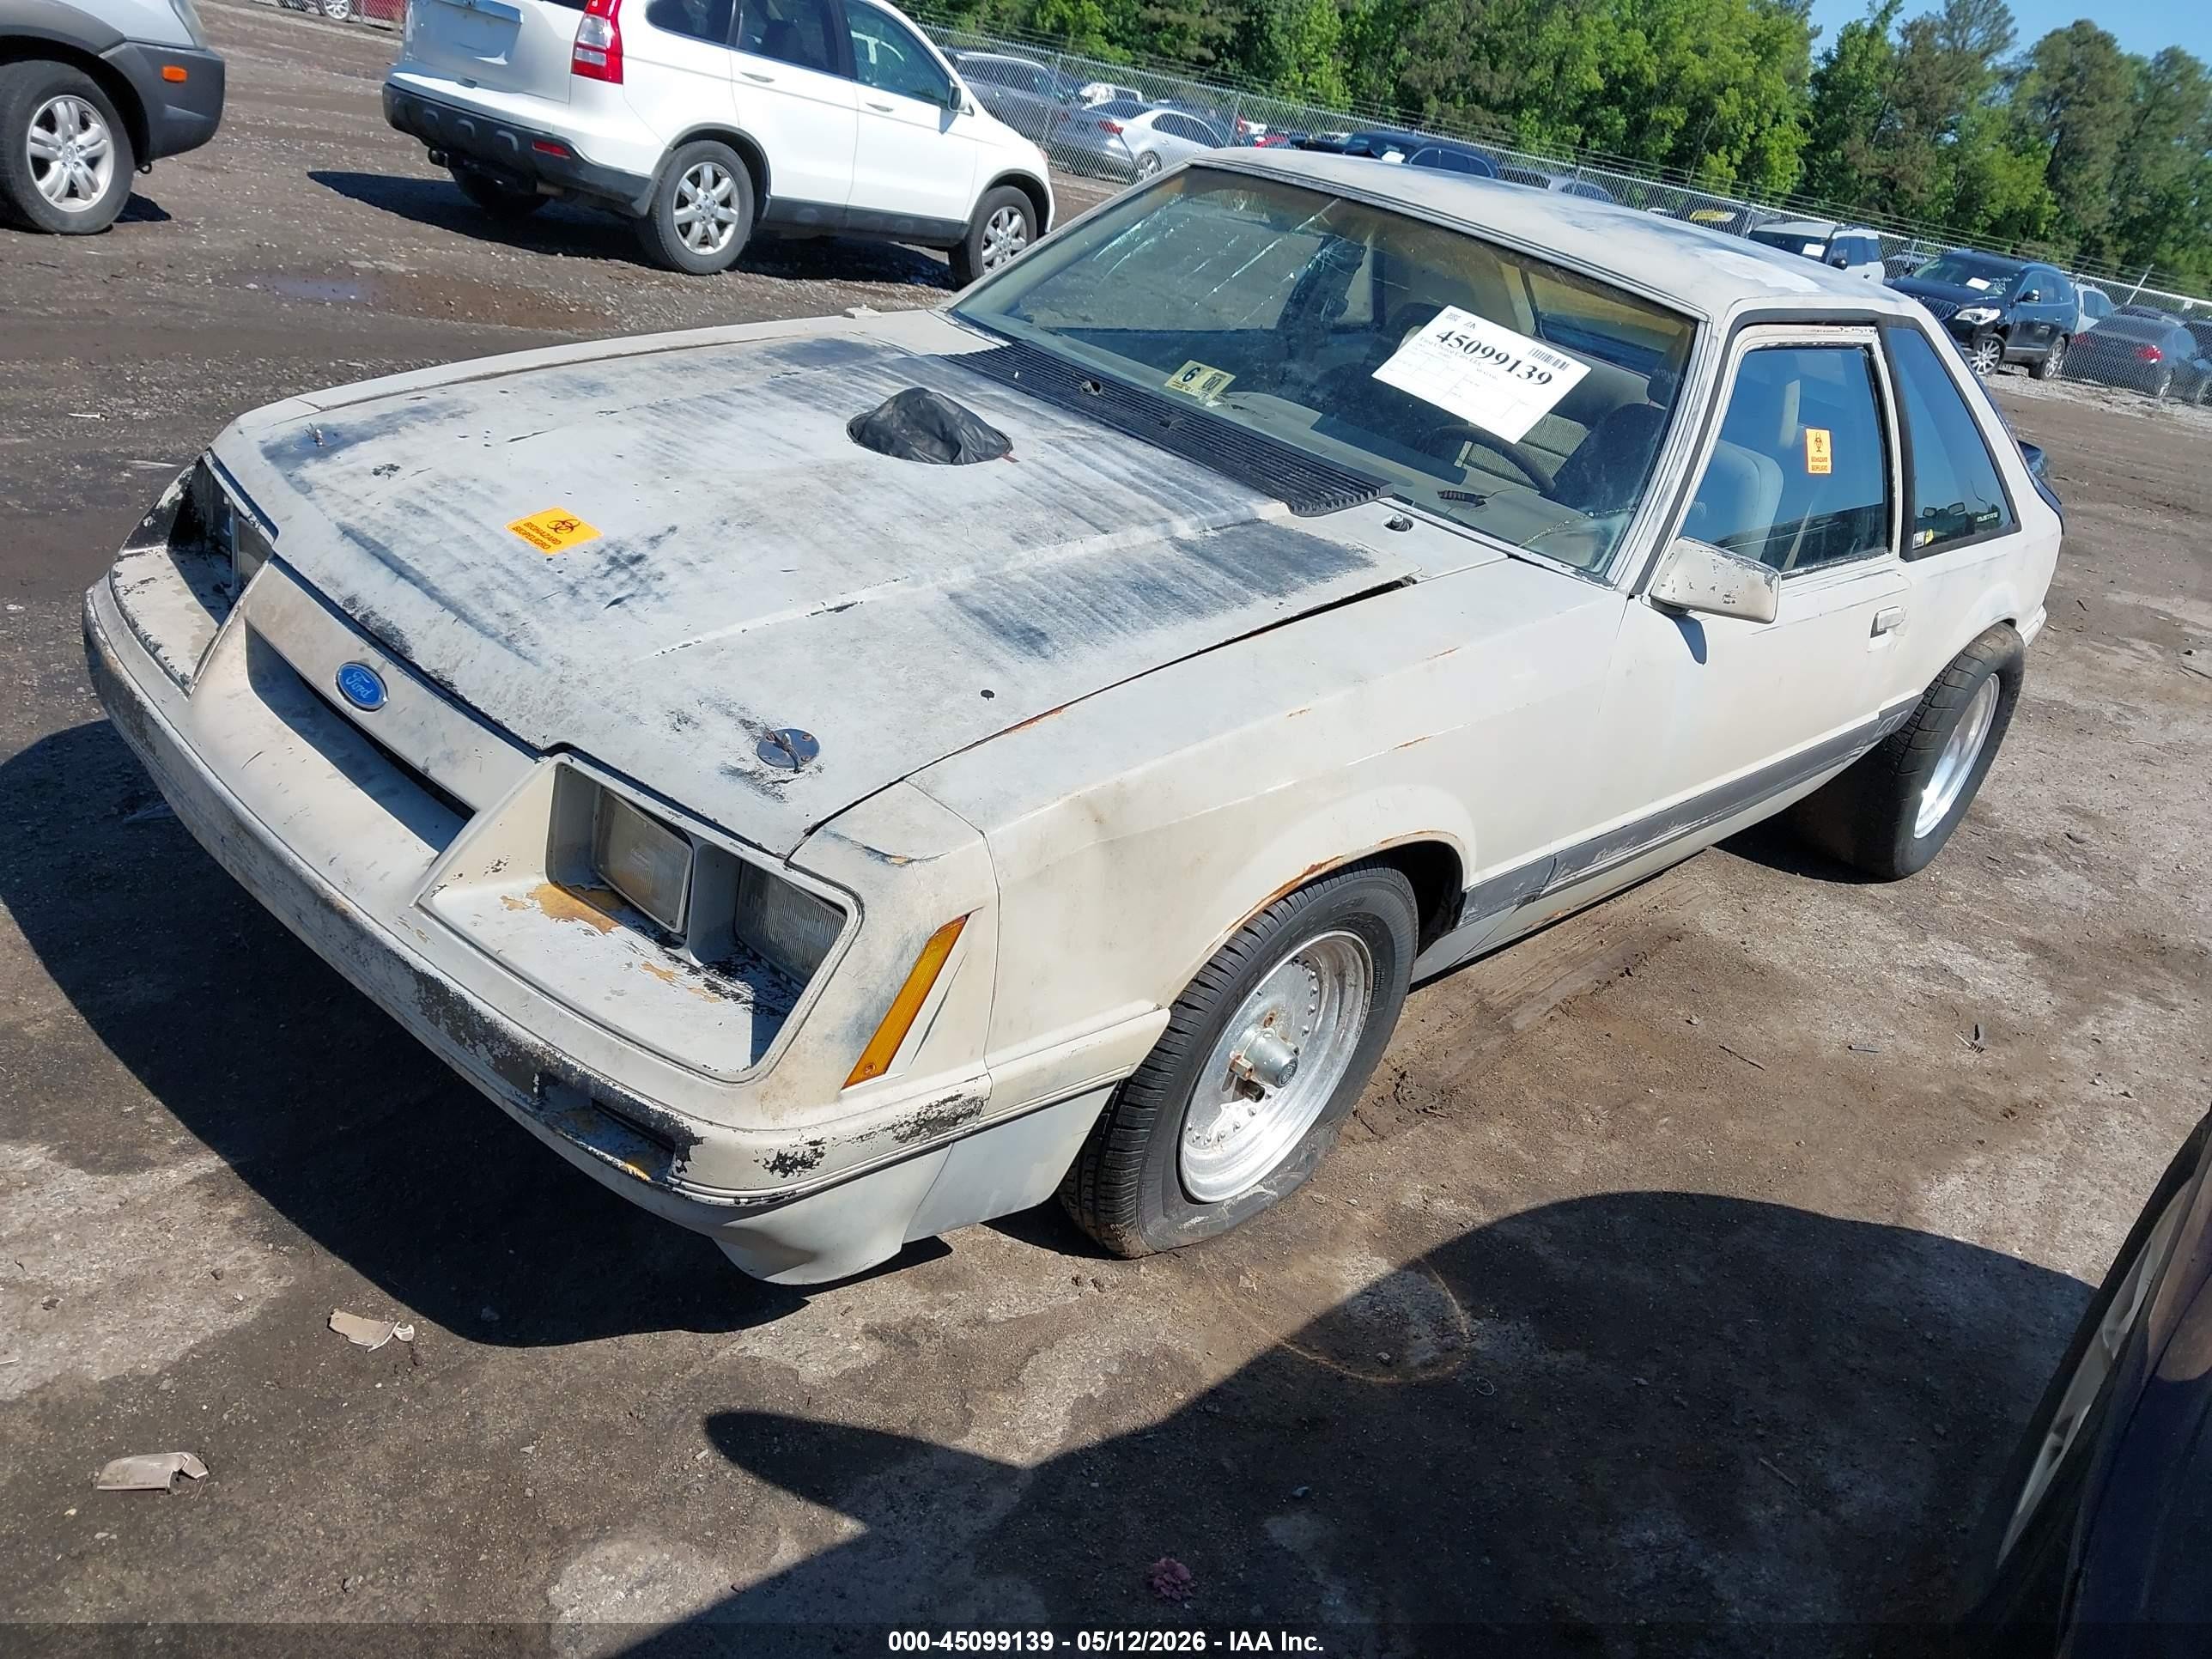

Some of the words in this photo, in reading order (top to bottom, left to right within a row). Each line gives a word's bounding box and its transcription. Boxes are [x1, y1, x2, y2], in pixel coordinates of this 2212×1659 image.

[1436, 330, 1553, 386] 45099139
[1182, 367, 1200, 382] 6
[345, 672, 373, 698] Ford
